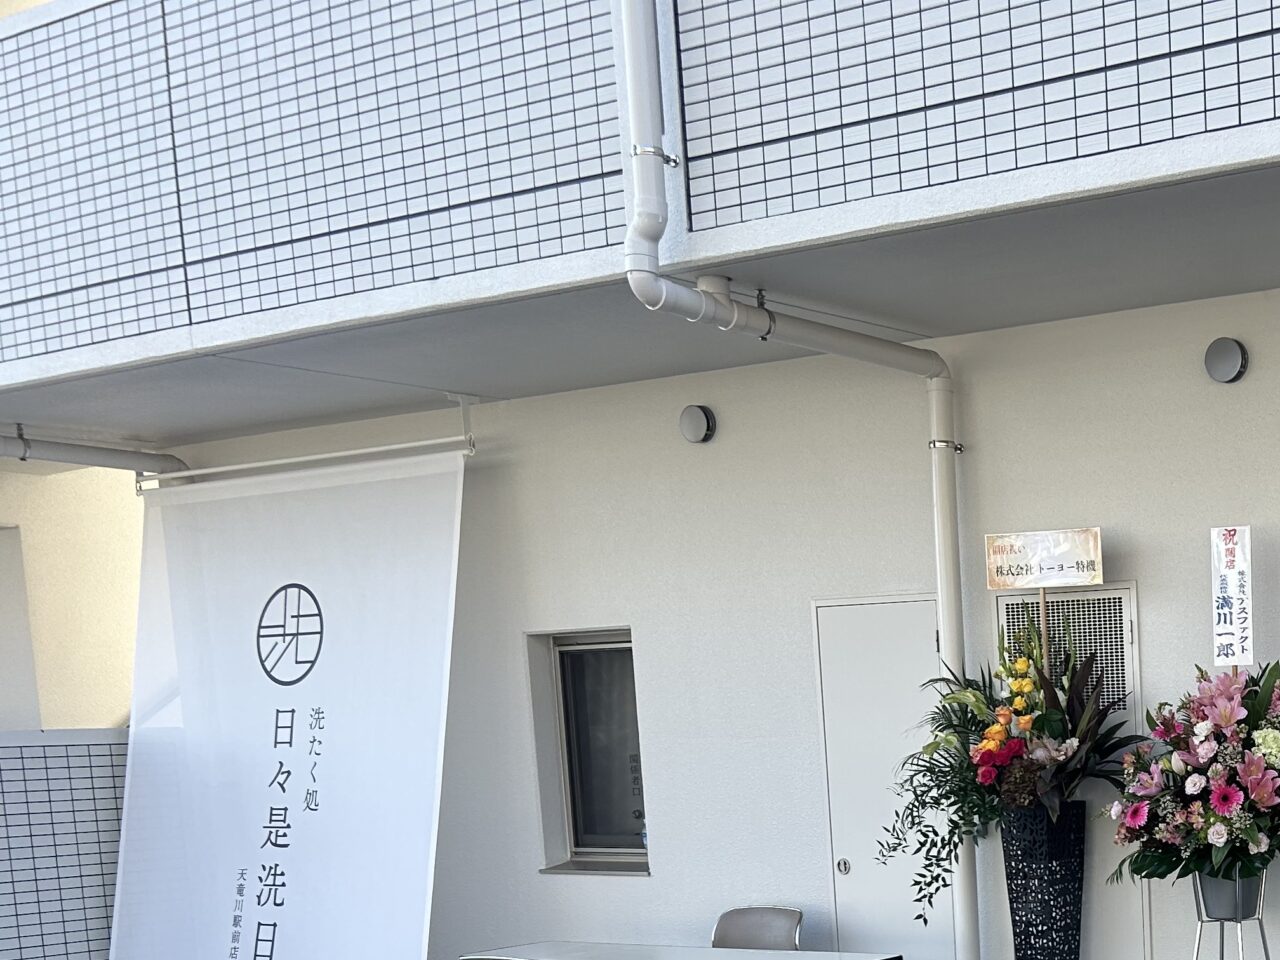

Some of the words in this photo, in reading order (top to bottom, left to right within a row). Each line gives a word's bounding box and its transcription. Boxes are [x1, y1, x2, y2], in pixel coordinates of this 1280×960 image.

[302, 706, 326, 813] 洗たく処
[228, 867, 248, 960] 天竜川駅前店
